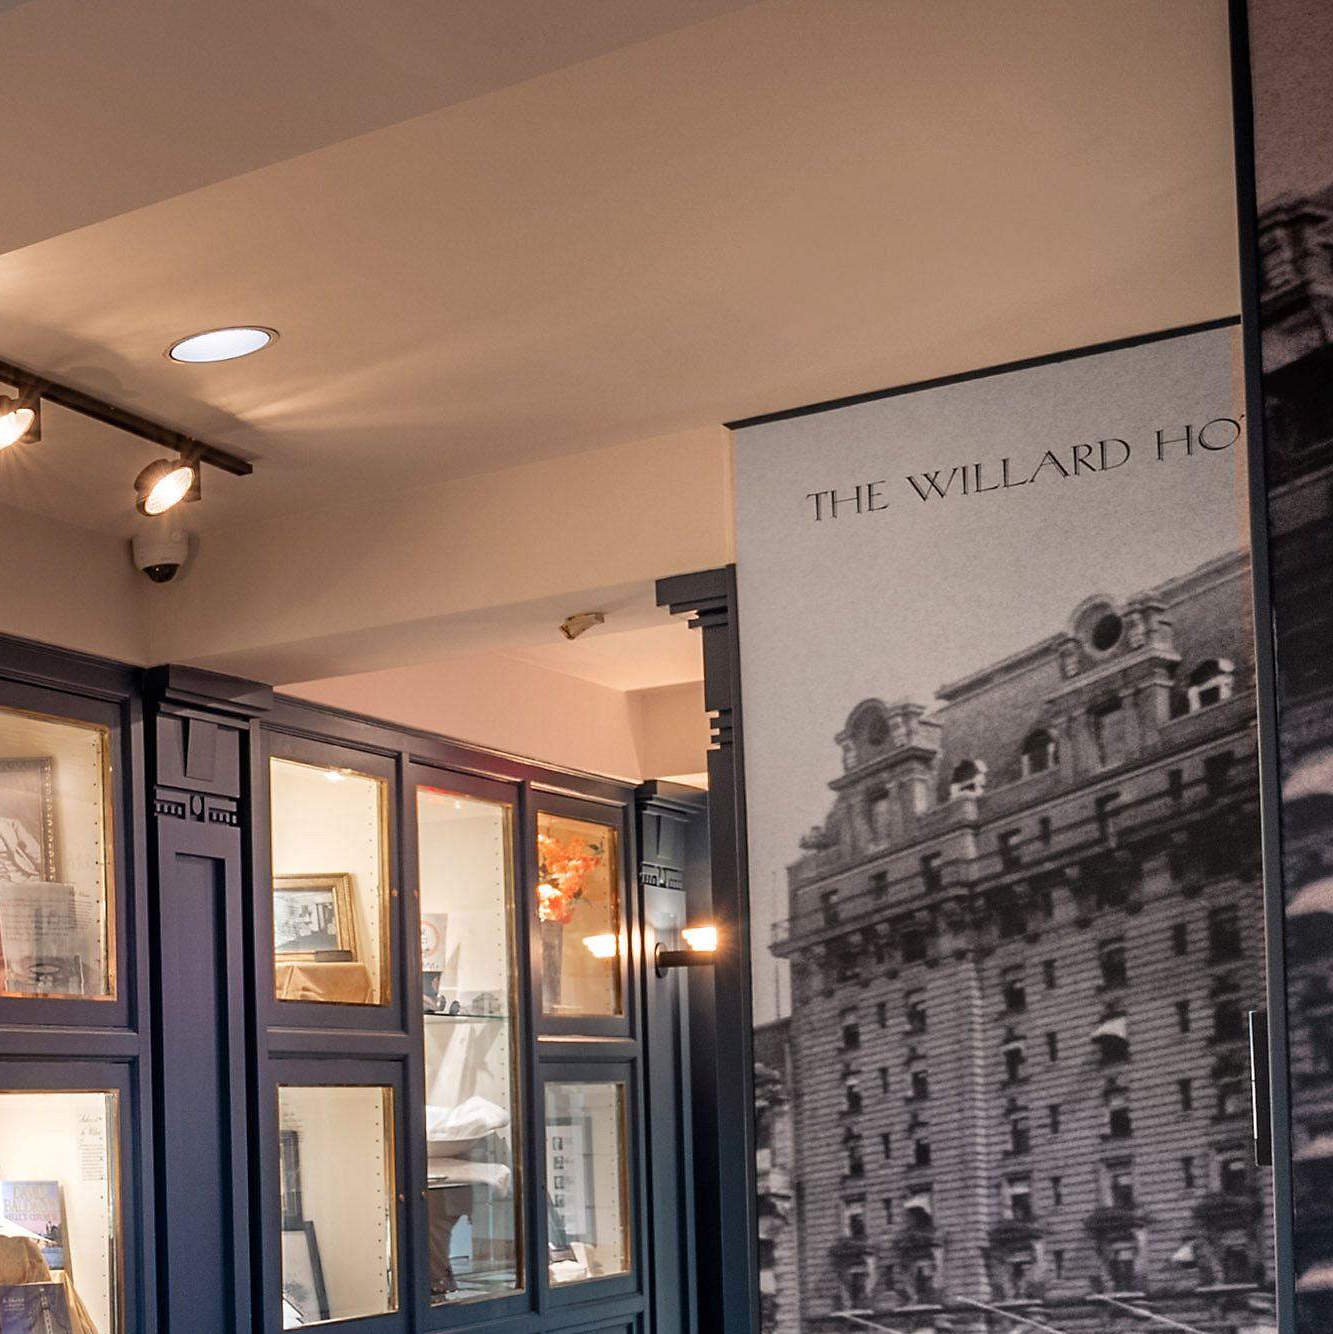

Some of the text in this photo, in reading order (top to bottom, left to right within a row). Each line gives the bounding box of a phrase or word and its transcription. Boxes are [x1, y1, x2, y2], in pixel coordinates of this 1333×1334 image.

[805, 413, 1245, 522] THE WILLARD HO
